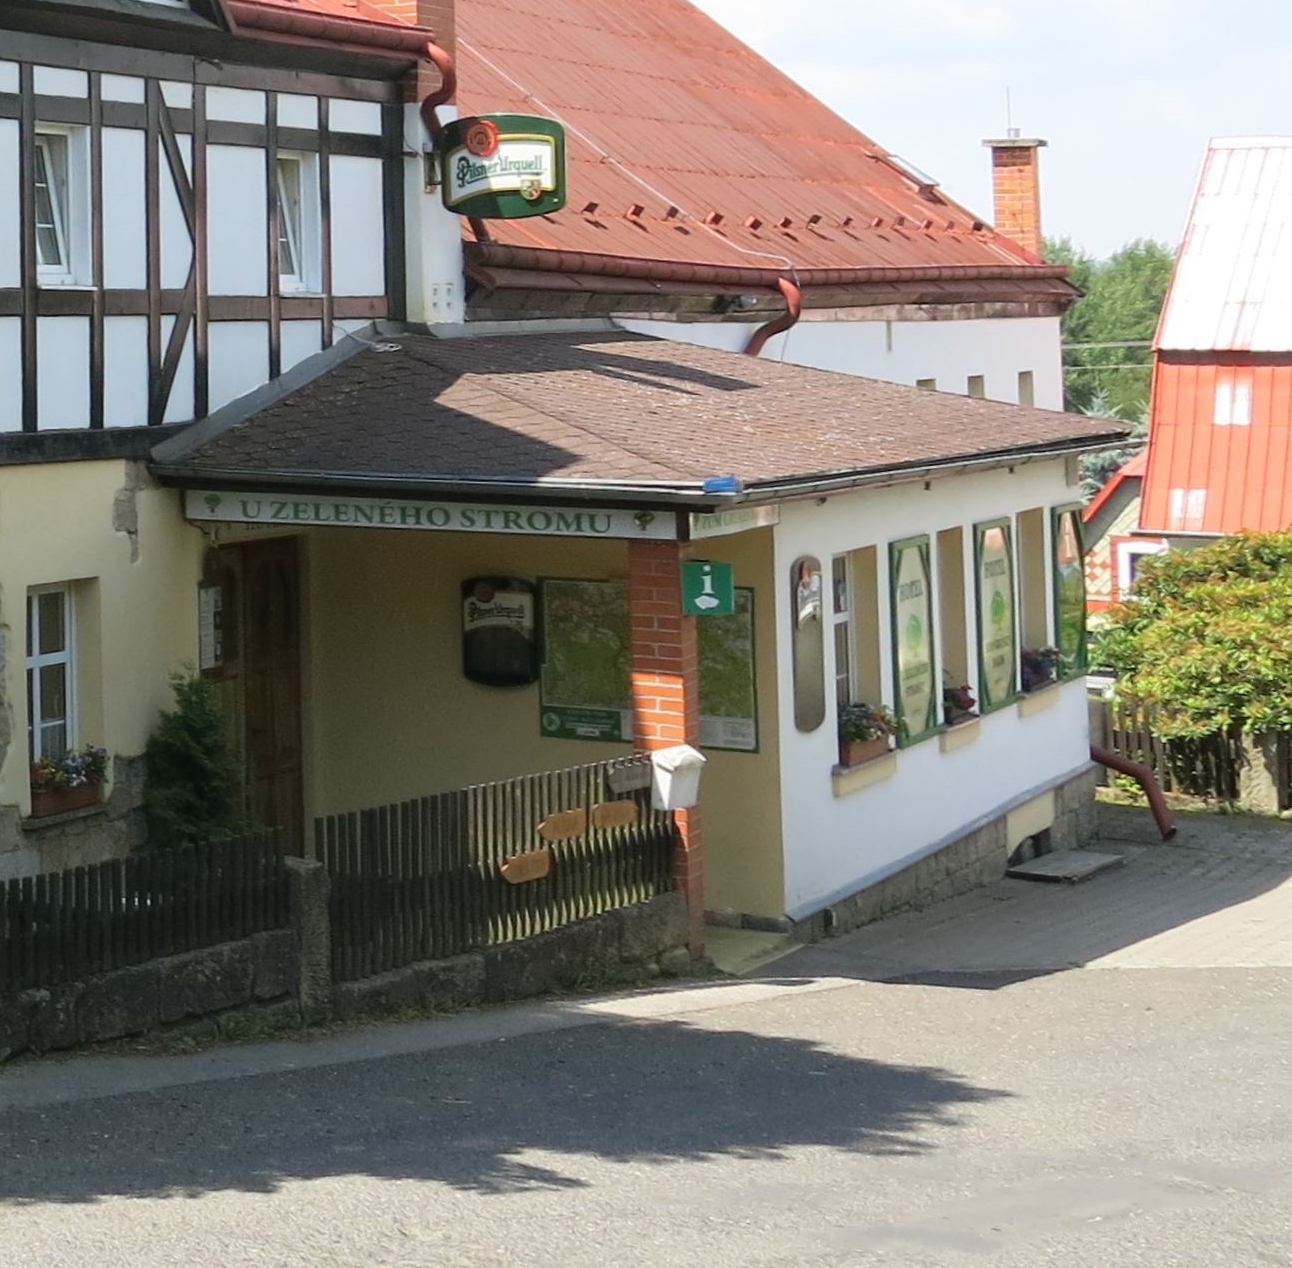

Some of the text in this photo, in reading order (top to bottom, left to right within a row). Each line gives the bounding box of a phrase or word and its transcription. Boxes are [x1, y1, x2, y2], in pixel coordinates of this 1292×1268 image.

[457, 154, 543, 188] Pilsner Urquell
[240, 499, 612, 533] U ZELENÉHO STROMU
